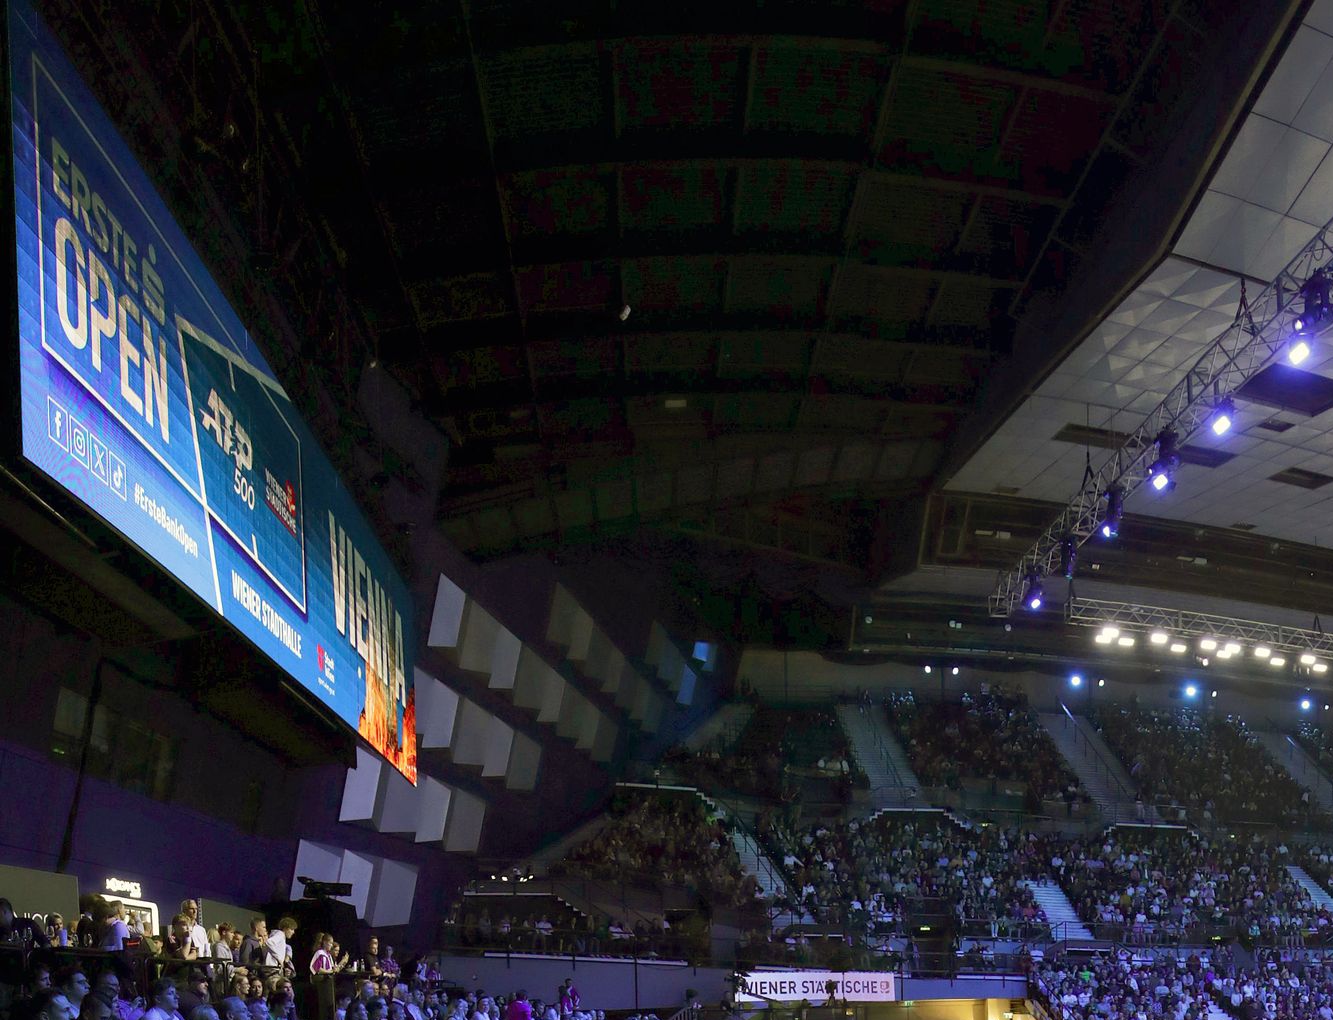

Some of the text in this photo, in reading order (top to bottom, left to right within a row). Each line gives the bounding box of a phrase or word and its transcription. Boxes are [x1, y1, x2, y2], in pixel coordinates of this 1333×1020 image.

[51, 136, 138, 293] ERSTE
[55, 217, 170, 444] OPEN
[199, 388, 252, 471] ATP
[134, 482, 199, 559] #ErsteBankOpen
[234, 467, 255, 511] 500
[232, 569, 302, 659] WIENER STADTHALLE
[801, 980, 878, 994] STÄTISCHE
